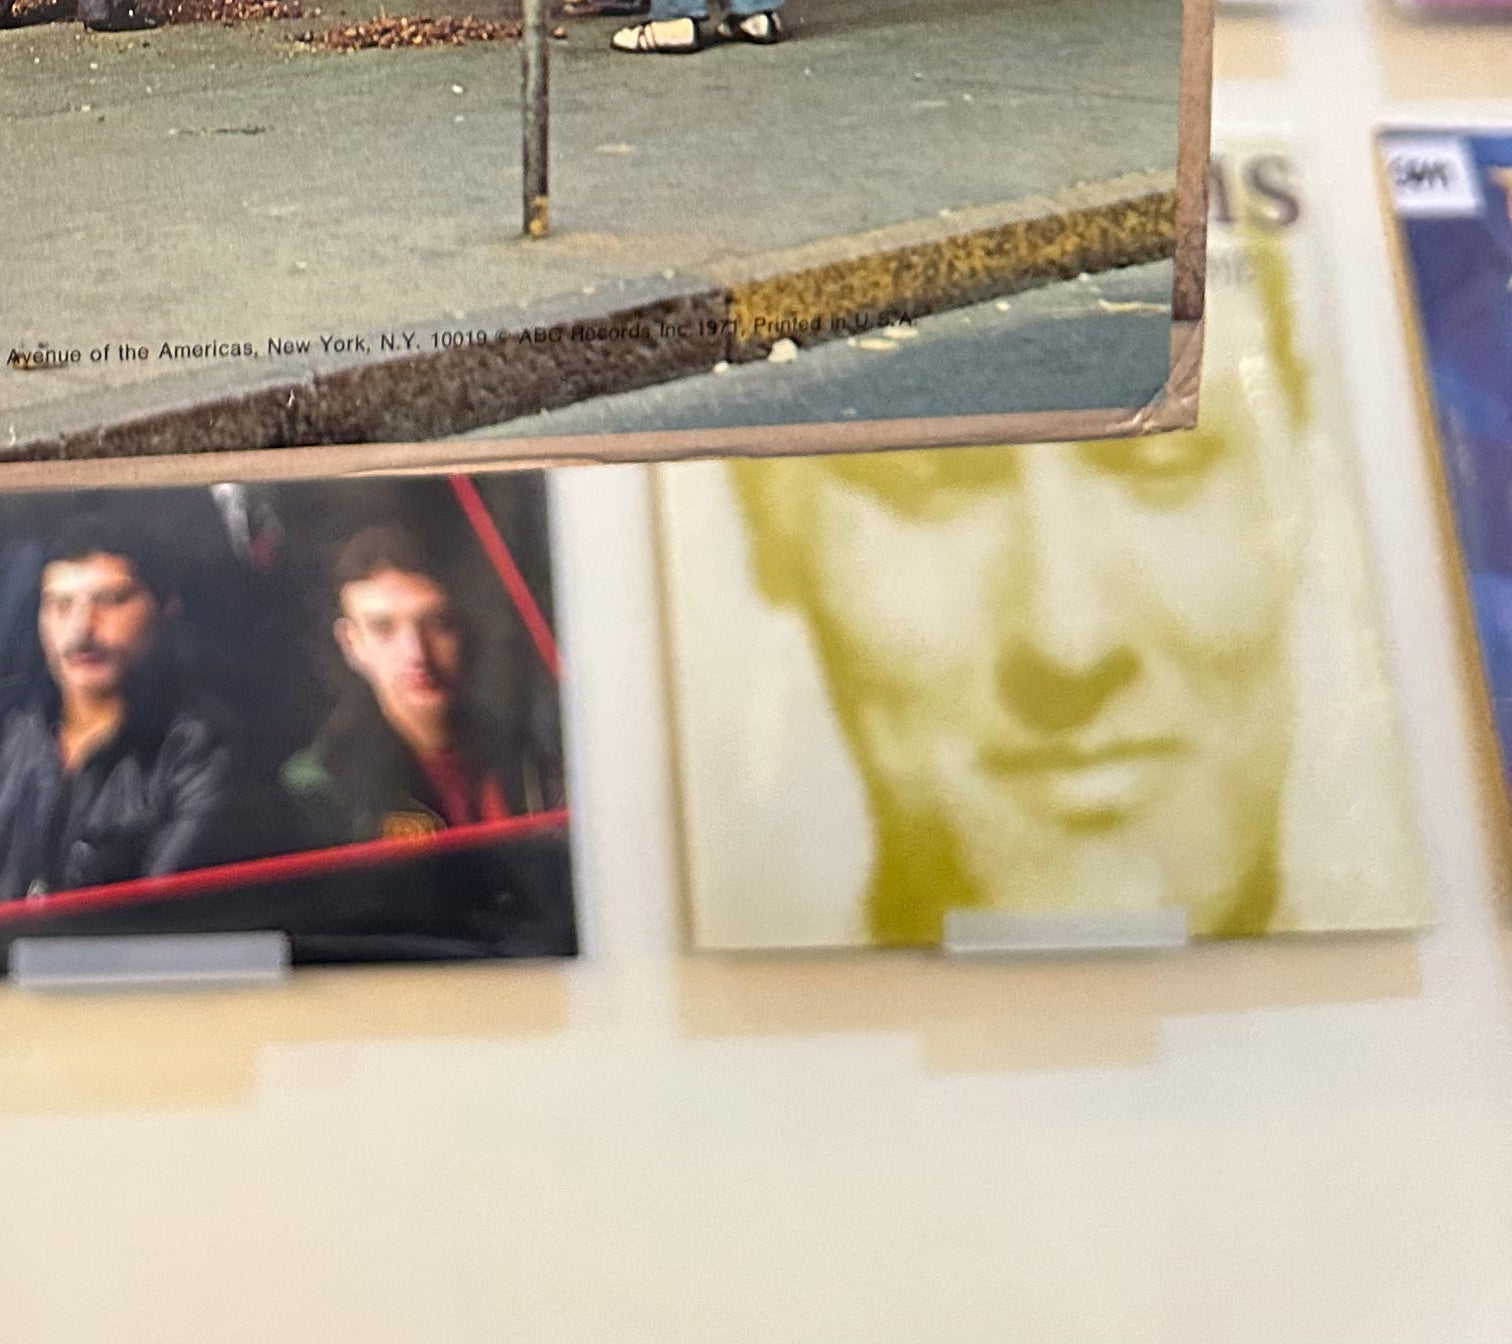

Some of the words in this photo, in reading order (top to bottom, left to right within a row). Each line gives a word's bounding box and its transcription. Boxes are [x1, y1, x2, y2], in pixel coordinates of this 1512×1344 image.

[6, 345, 82, 367] Avenue
[89, 343, 110, 363] of
[118, 343, 150, 362] the
[158, 339, 259, 361] Americas,
[267, 337, 311, 357] New
[320, 334, 371, 356] York,
[380, 331, 421, 351] N.Y.
[430, 329, 488, 348] 10019
[518, 325, 564, 346] ABC
[753, 313, 823, 335] Printed
